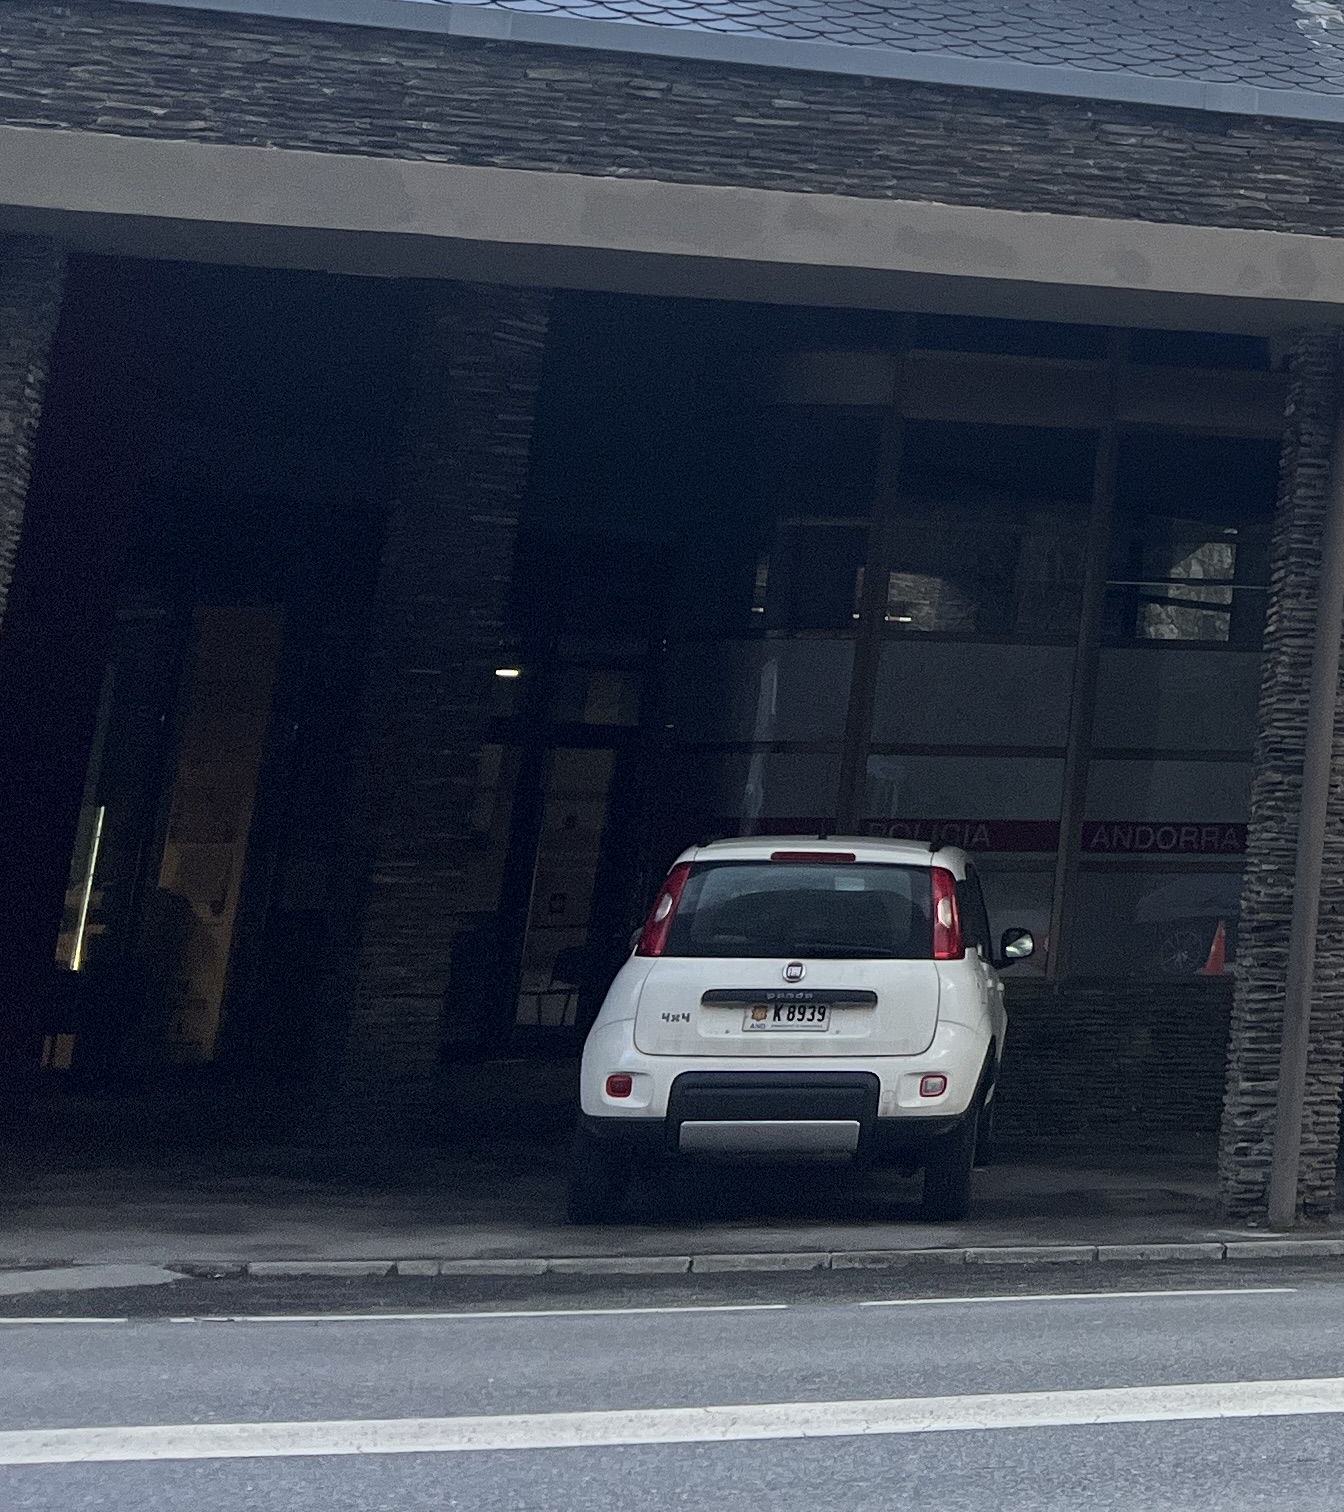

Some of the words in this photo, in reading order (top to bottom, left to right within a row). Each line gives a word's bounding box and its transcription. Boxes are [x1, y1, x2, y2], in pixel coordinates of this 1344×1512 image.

[1090, 825, 1243, 850] ANDORRA
[773, 1005, 783, 1021] K
[786, 1005, 826, 1021] 8939
